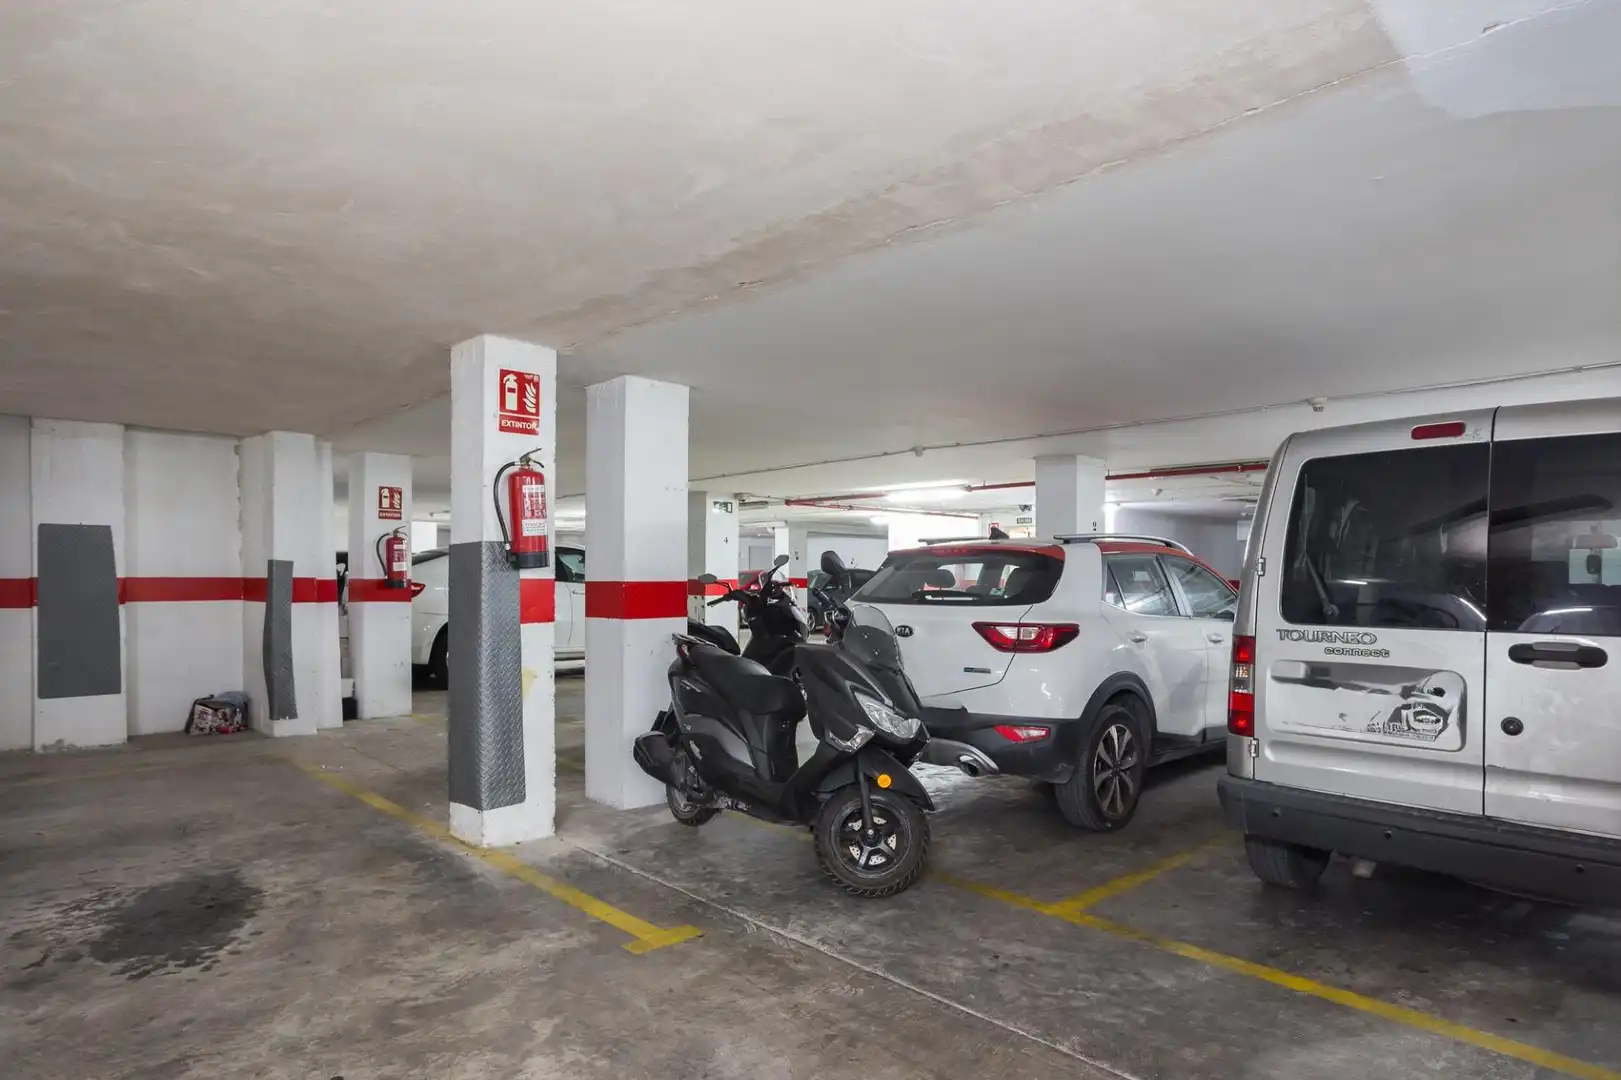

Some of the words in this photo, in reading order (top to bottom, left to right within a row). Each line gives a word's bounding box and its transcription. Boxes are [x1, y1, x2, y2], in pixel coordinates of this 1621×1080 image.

[501, 419, 537, 430] EXTINTOR
[1276, 628, 1378, 645] TOURNEO
[1323, 646, 1390, 658] connect
